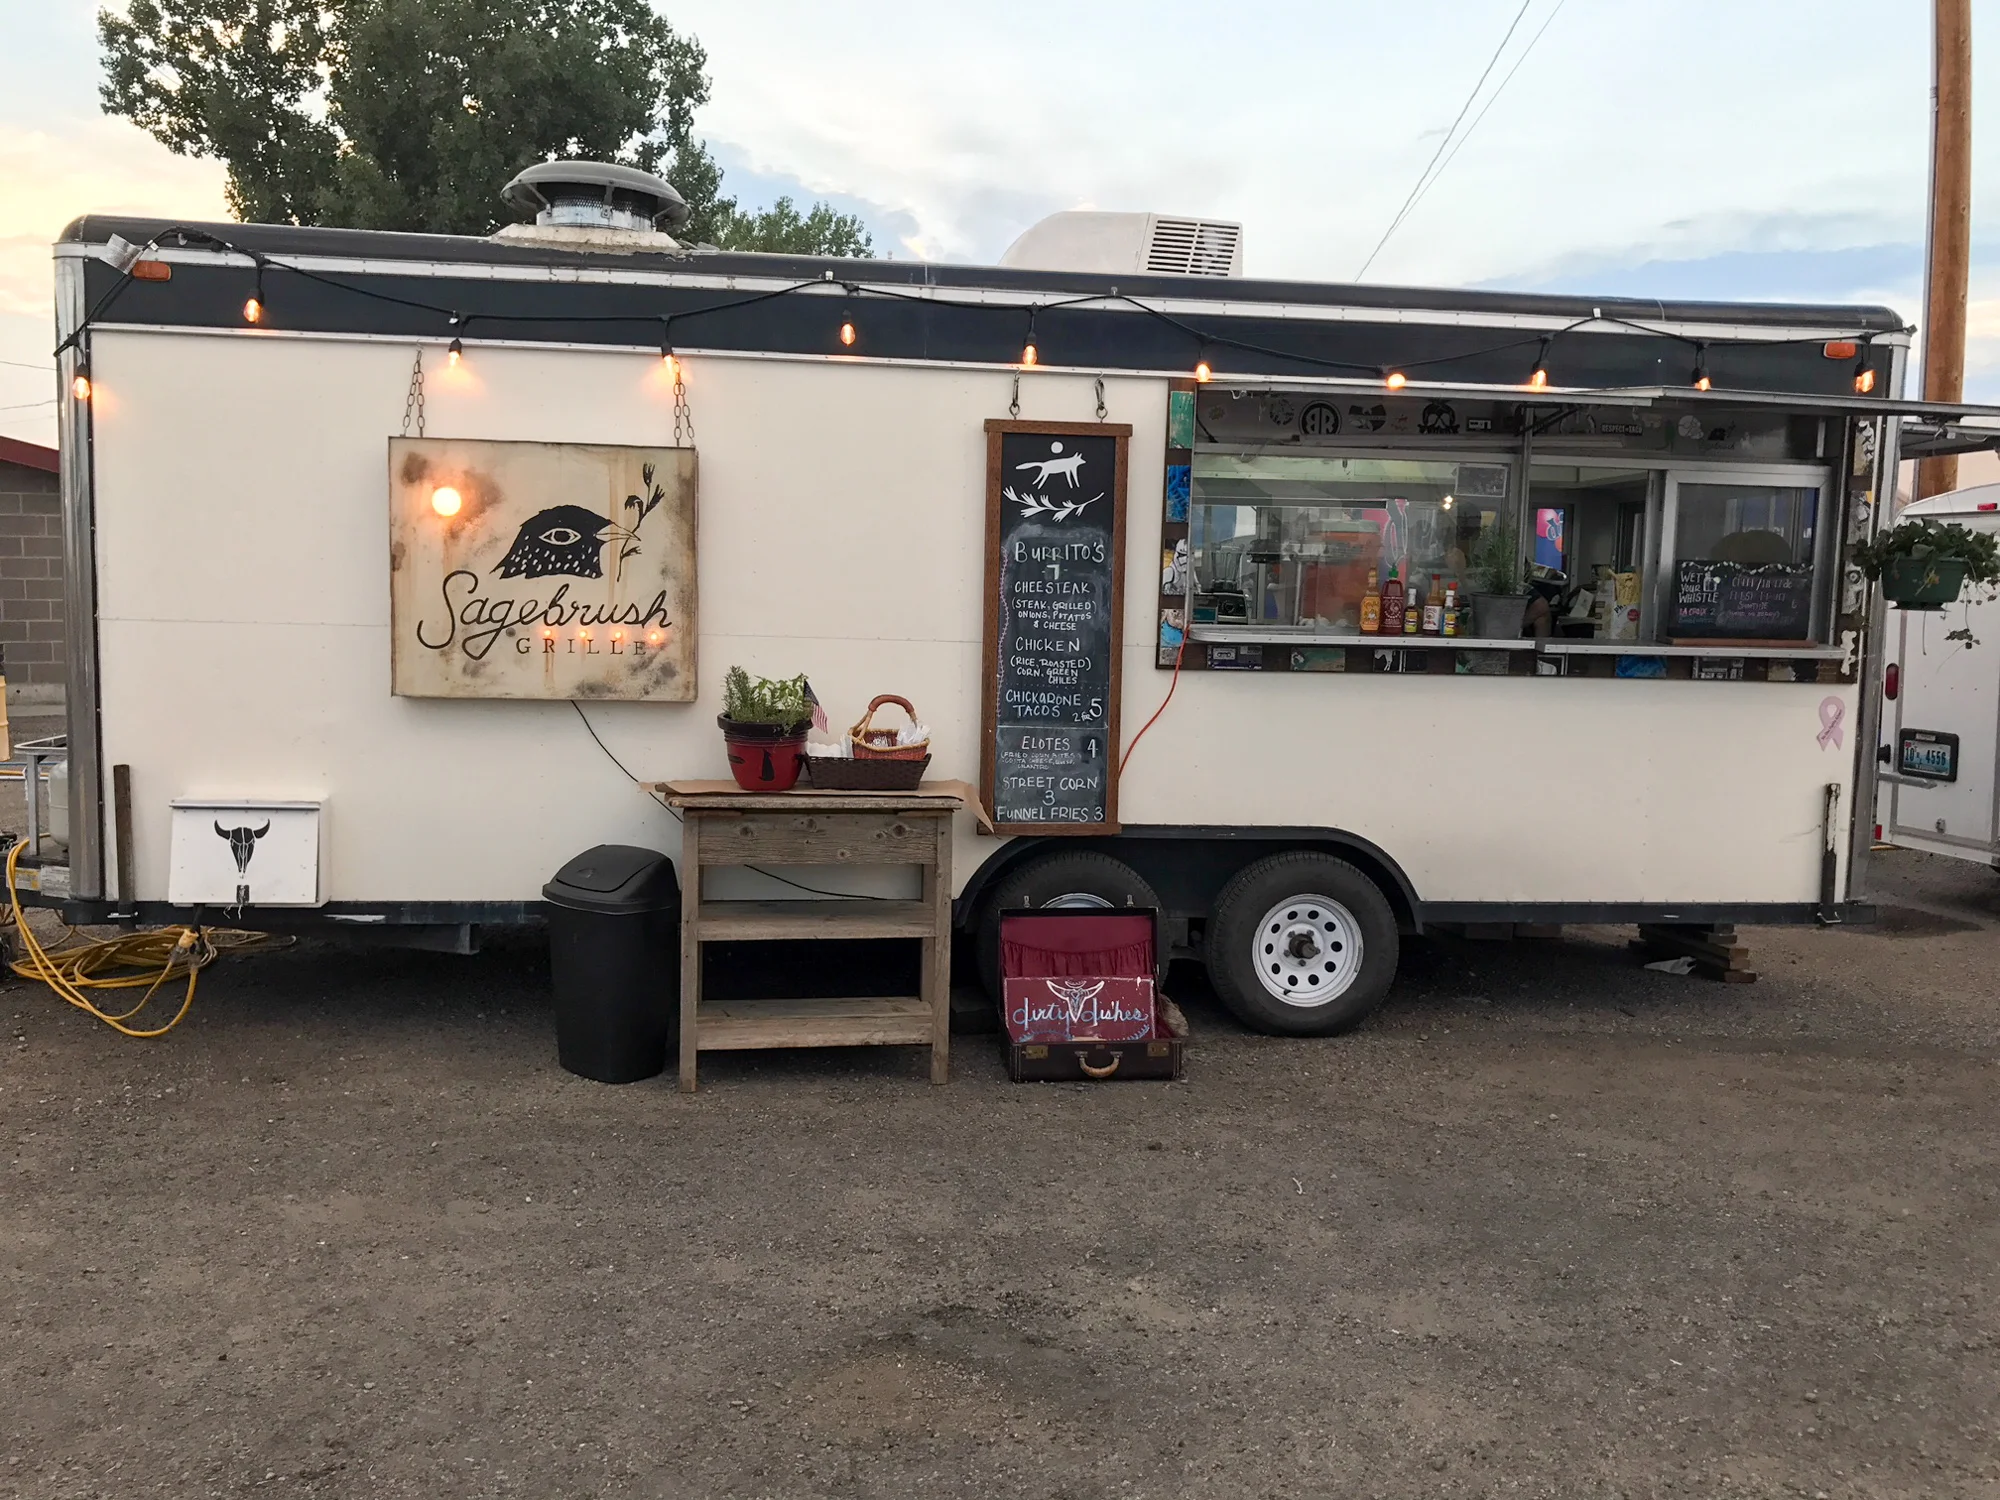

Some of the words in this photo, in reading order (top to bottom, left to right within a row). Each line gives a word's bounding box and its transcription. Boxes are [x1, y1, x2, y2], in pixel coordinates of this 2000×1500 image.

[1680, 571, 1703, 583] WET
[1014, 581, 1091, 595] CHEESTEAK
[1681, 583, 1701, 594] YOUR
[1678, 592, 1719, 603] WHISTLE
[417, 569, 673, 661] Sagebrush
[1053, 611, 1092, 622] POTATOS
[1043, 621, 1077, 631] CHEESE
[515, 637, 648, 656] GRILLE
[1015, 636, 1080, 652] CHICKEN
[1046, 667, 1079, 678] GREEN
[1048, 676, 1077, 685] CHILES
[1012, 704, 1061, 718] TACOS
[1089, 698, 1103, 718] 5
[1021, 736, 1071, 751] ELOTES
[1002, 777, 1055, 790] STREET
[1060, 777, 1098, 790] CORN
[1042, 790, 1055, 806] 3
[996, 806, 1046, 821] FUNNEL
[1051, 807, 1089, 823] FRIES
[1094, 807, 1104, 821] 3
[1012, 997, 1071, 1036] dirty
[1081, 997, 1148, 1027] dishes
